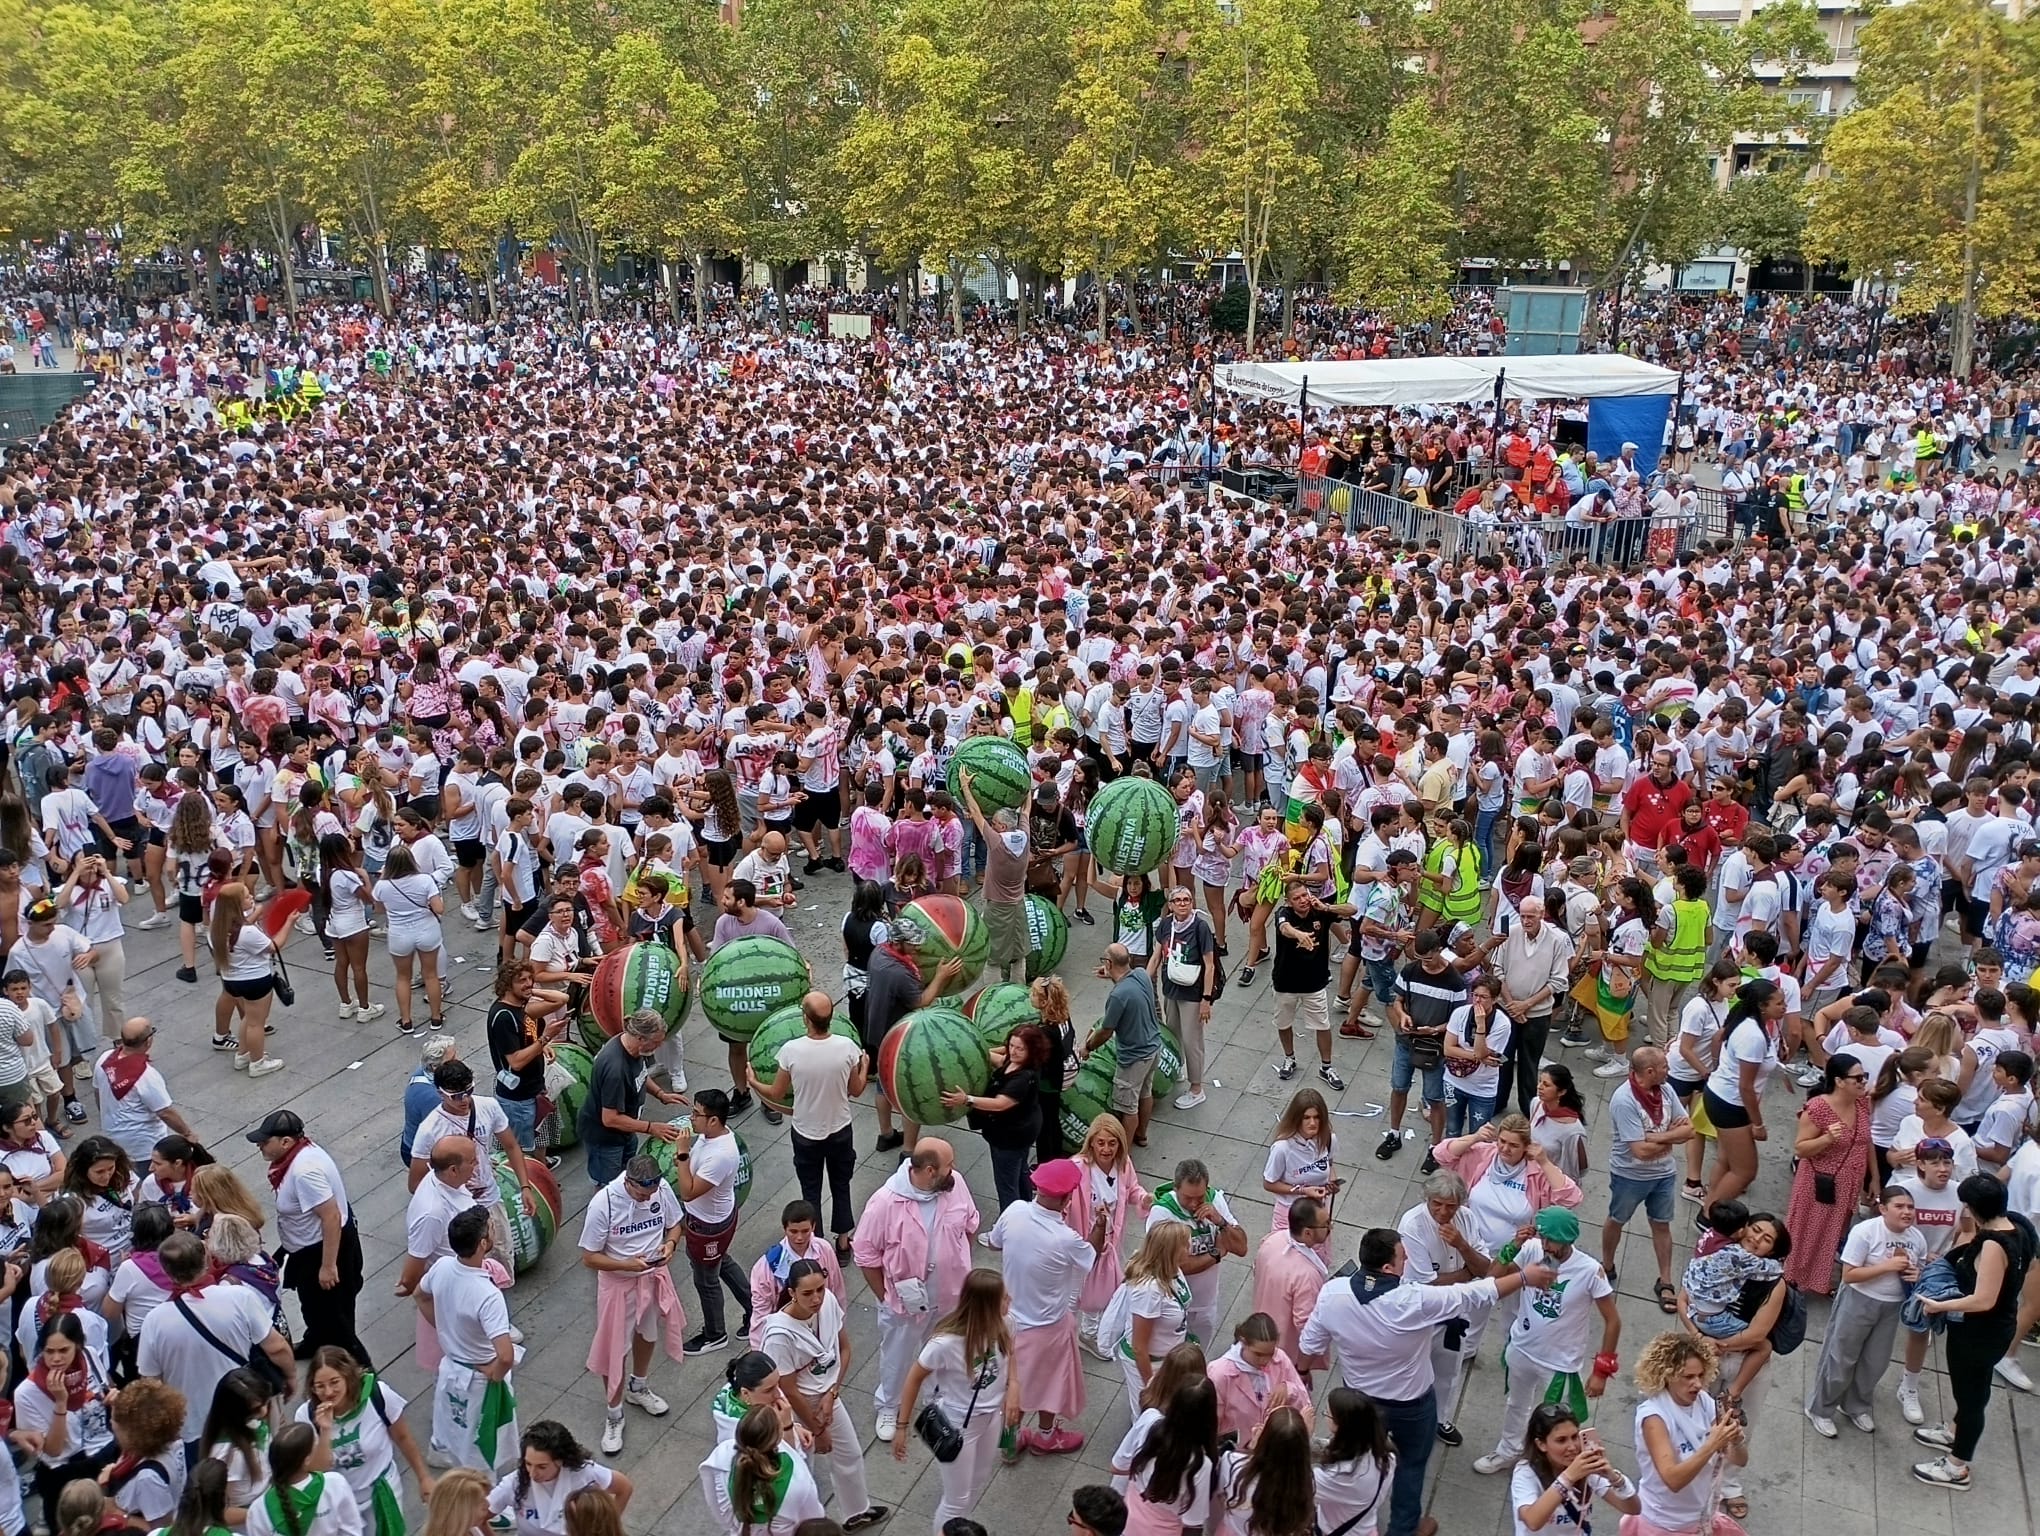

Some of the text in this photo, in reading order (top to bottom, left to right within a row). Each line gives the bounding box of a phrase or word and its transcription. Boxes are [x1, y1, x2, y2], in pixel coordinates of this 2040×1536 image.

[1233, 376, 1261, 390] Ayuntamiento
[1262, 383, 1268, 391] de
[1002, 758, 1025, 776] STOP
[1114, 817, 1137, 873] PALESTINA
[1128, 835, 1145, 865] LIBRE
[1025, 900, 1042, 951] GENOCIDE
[1036, 909, 1049, 937] STOP
[642, 955, 660, 1009] GENOCID
[658, 969, 671, 1004] STOP
[715, 985, 781, 999] GENOCIDE
[730, 1000, 766, 1012] STOP
[612, 1216, 663, 1236] #PEÑASTER
